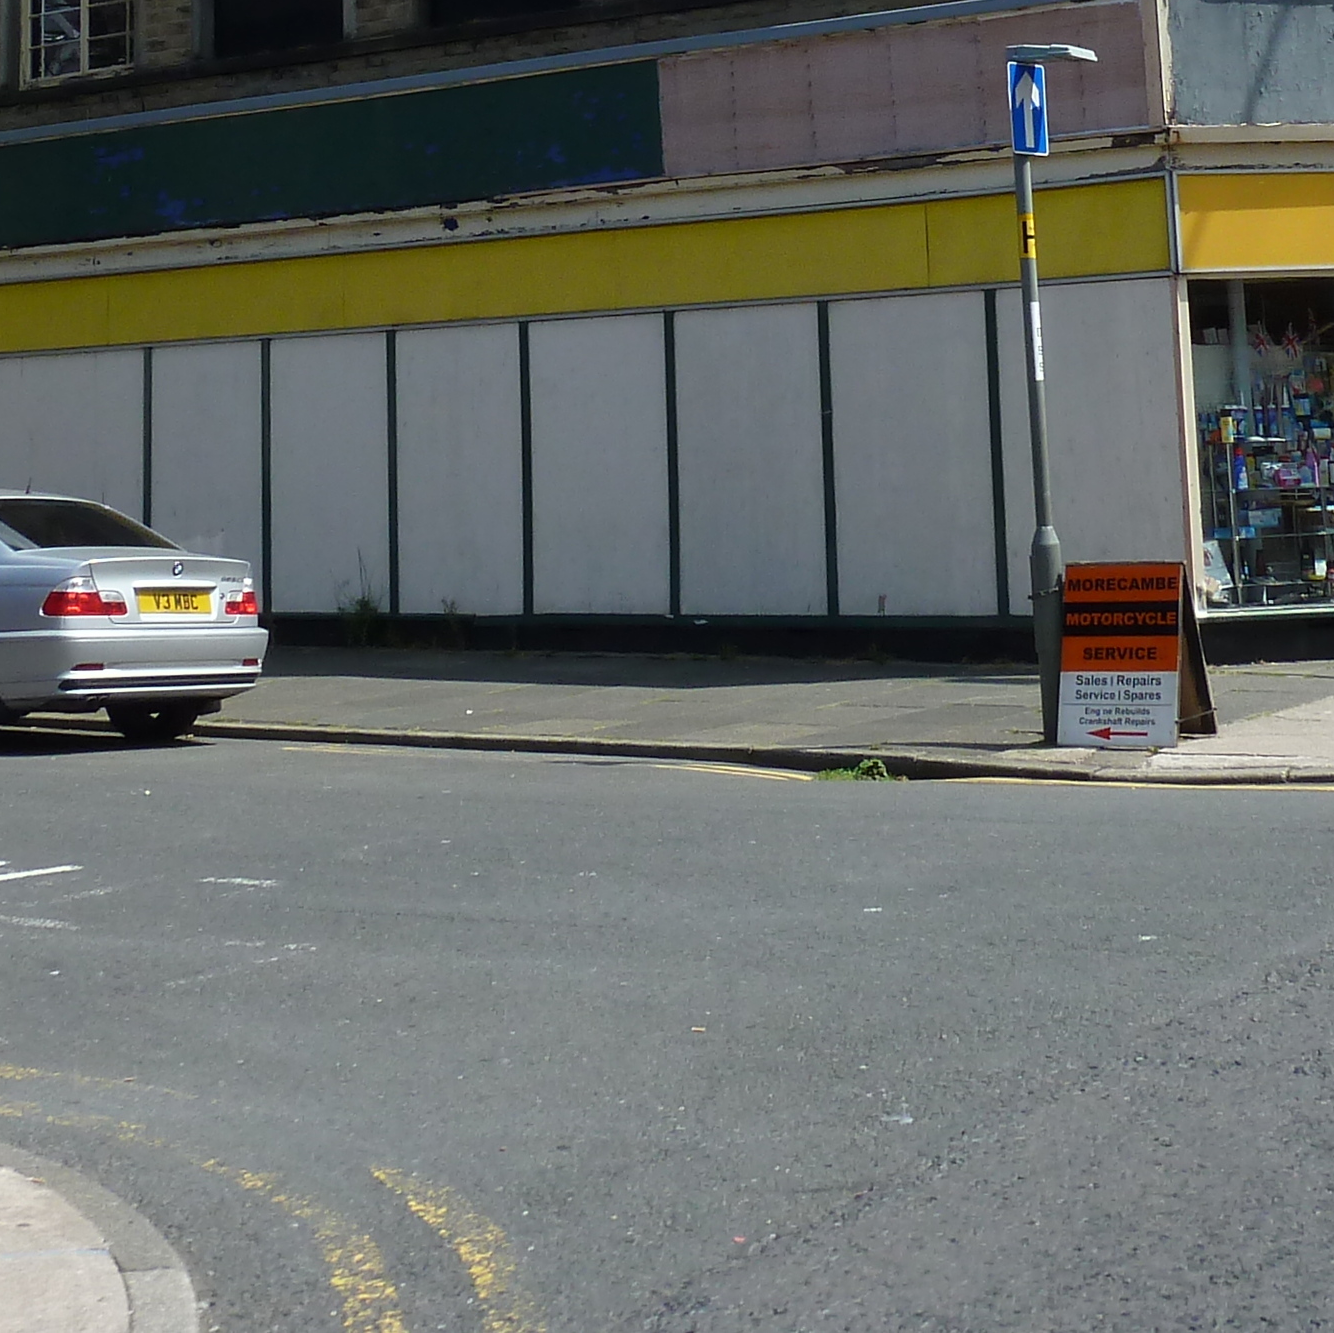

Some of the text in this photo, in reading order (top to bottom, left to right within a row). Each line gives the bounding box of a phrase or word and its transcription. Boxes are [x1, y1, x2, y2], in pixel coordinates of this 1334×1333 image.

[1067, 576, 1177, 592] MORECAMBE
[152, 593, 199, 610] V3 MBC
[1066, 611, 1177, 626] MOTORCYCLE
[1083, 647, 1157, 661] SERVICE
[1075, 675, 1162, 689] Sales Repairs
[1075, 690, 1162, 702] Service Spares
[1084, 707, 1113, 717] Engne
[1124, 717, 1156, 727] Repairs
